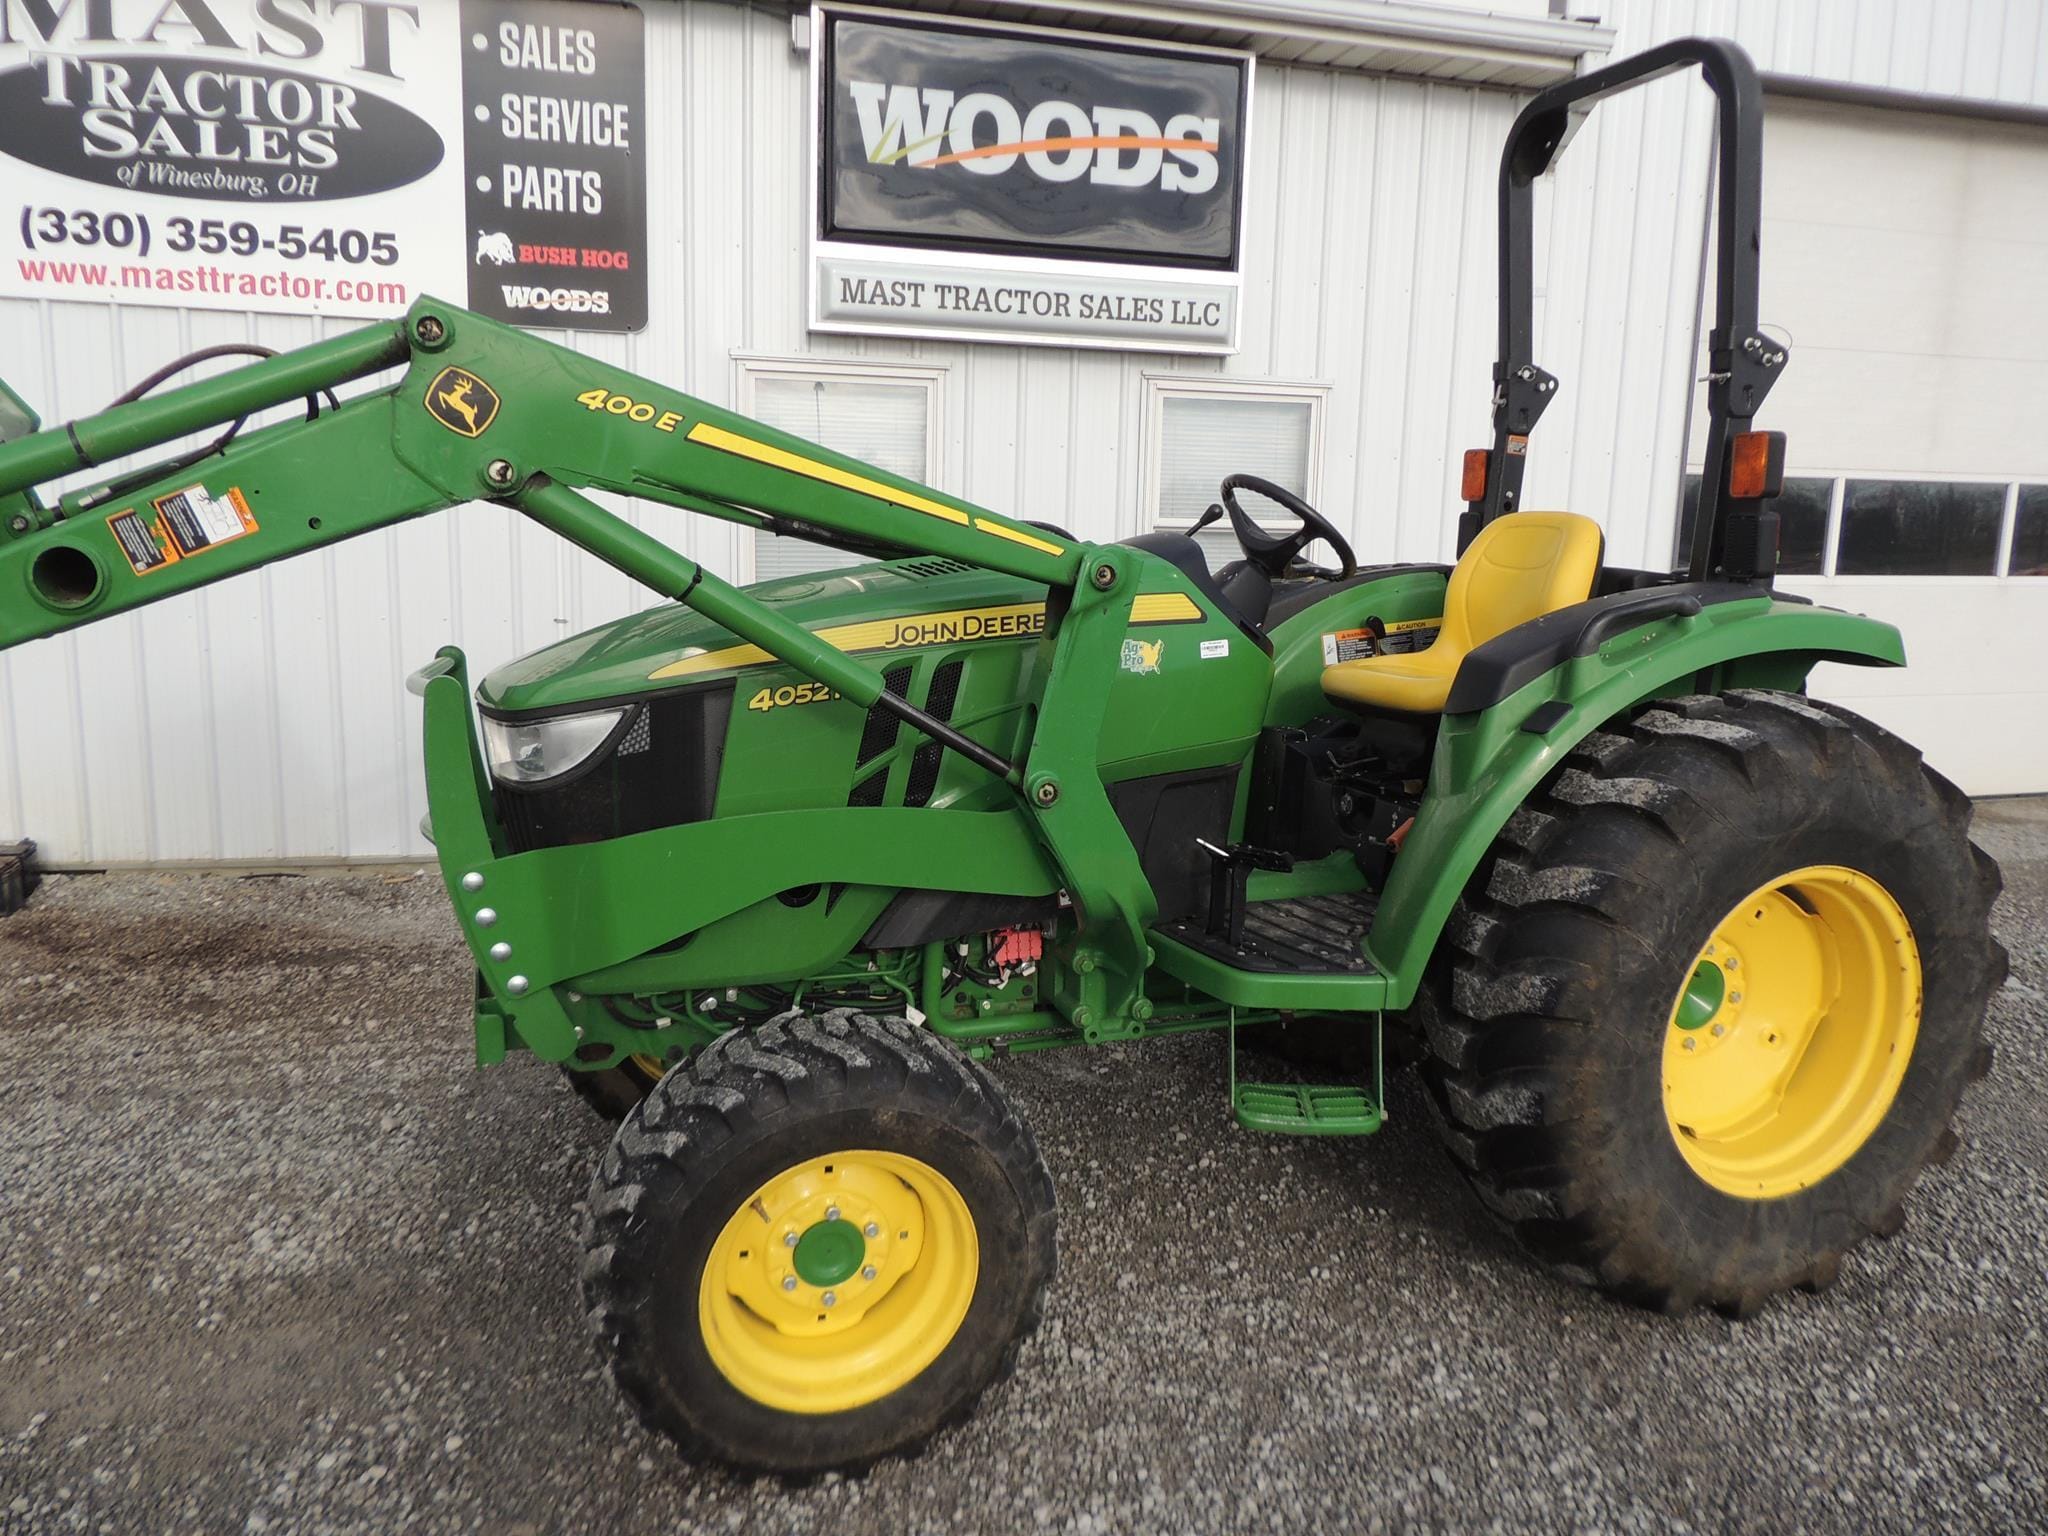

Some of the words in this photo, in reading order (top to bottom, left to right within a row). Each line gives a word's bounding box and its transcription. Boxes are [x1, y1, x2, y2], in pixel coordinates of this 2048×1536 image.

[499, 21, 597, 75] SALES
[29, 51, 361, 131] TRACTOR
[82, 108, 340, 169] SALES
[501, 92, 629, 149] SERVICE
[850, 80, 1220, 195] WOODS
[117, 162, 146, 188] of
[148, 162, 269, 197] Winesburg,
[278, 173, 319, 196] OH
[503, 163, 602, 215] PARTS
[19, 205, 151, 257] (330)
[165, 217, 400, 266] 359-5405
[519, 244, 577, 267] BUSH
[581, 248, 629, 270] HOG
[17, 258, 407, 305] www.masttractor.com
[501, 284, 610, 314] WOODS
[840, 277, 926, 309] MAST
[934, 284, 1072, 318] TRACTOR
[1079, 294, 1164, 324] SALES
[1171, 299, 1221, 327] LLC
[885, 620, 959, 646] JOHN
[962, 613, 1046, 637] DEERE
[1401, 621, 1427, 630] CAUTION
[1123, 654, 1144, 666] Pro
[748, 681, 841, 711] 4052
